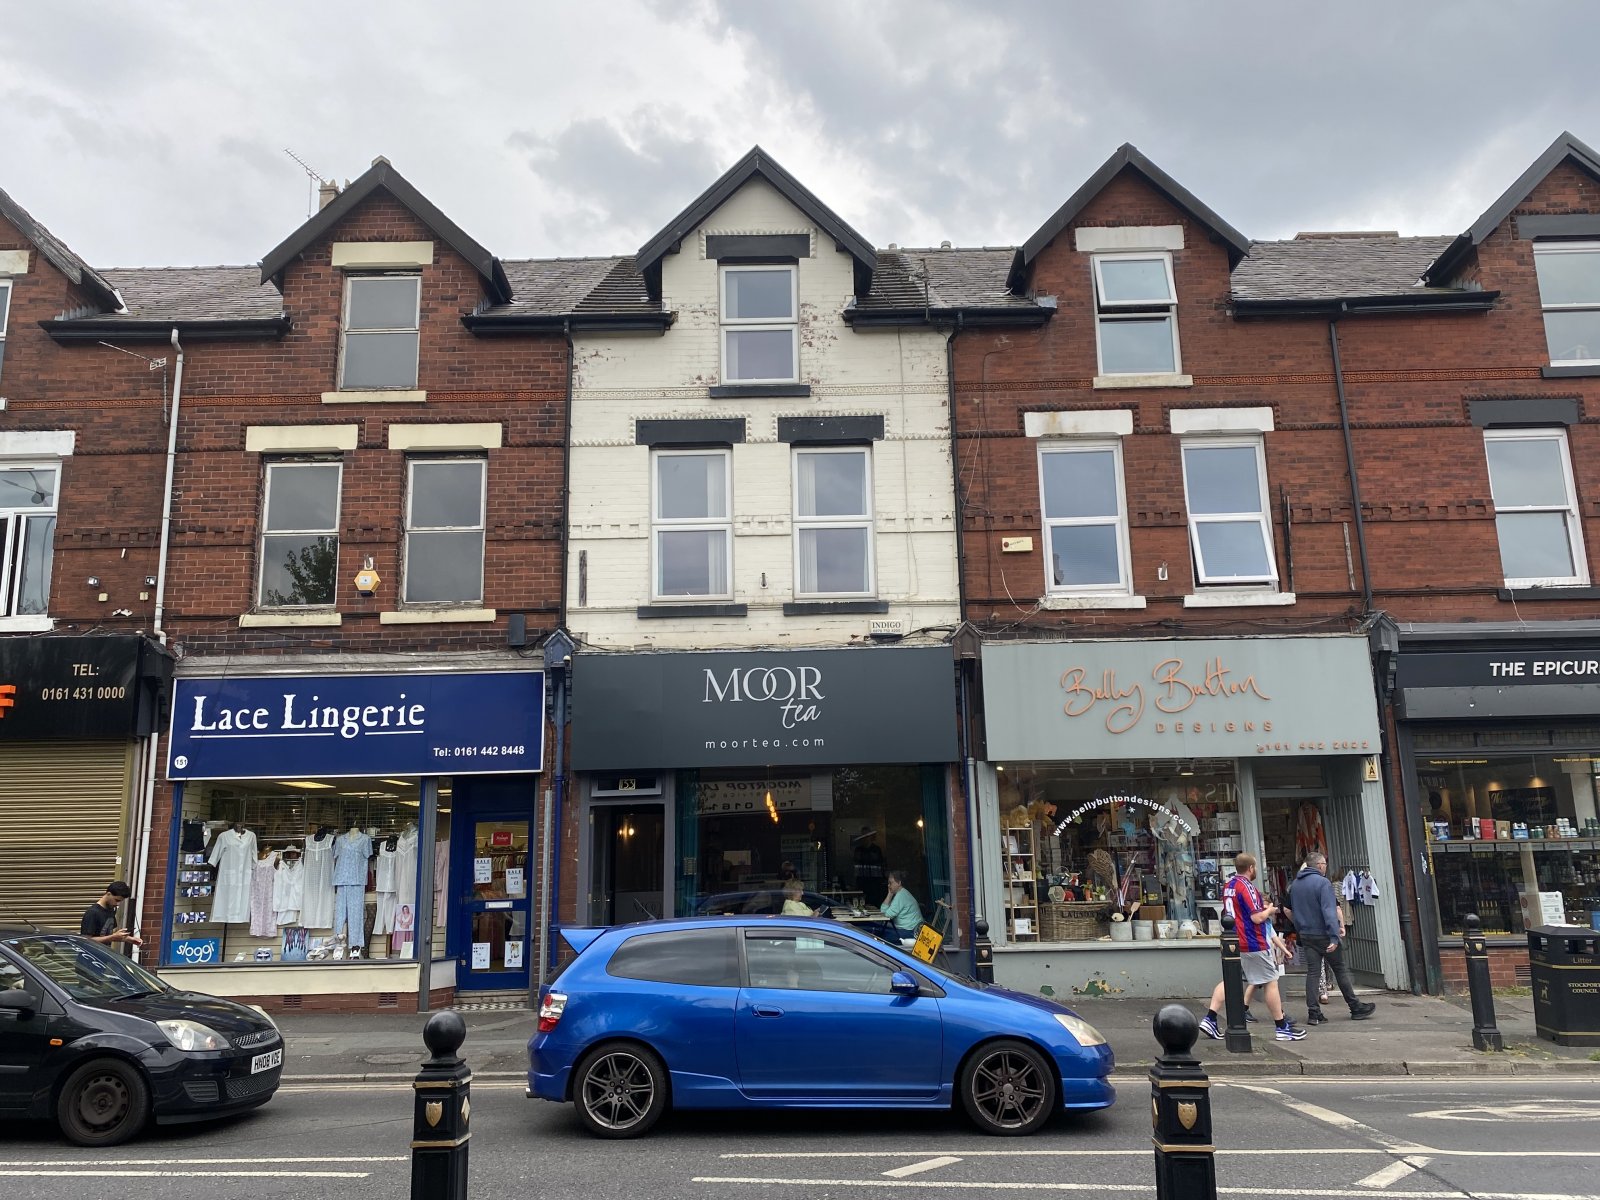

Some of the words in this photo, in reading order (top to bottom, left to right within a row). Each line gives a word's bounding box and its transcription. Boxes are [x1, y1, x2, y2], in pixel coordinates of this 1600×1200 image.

[872, 621, 901, 629] INDIGO
[72, 663, 100, 676] TEL:
[1489, 661, 1526, 677] THE
[1532, 660, 1600, 676] EPICUR
[702, 666, 826, 703] MOOR
[42, 687, 69, 700] 0161
[72, 687, 94, 699] 431
[97, 686, 125, 699] 0000
[1060, 667, 1145, 734] Belly
[1152, 656, 1272, 713] Button
[190, 695, 269, 731] Lace
[280, 693, 425, 739] Lingerie
[779, 697, 821, 729] tea
[1155, 720, 1274, 733] DESIGNS
[705, 738, 825, 749] moortea.com
[1256, 741, 1291, 754] 0161
[1299, 741, 1325, 751] 442
[433, 747, 452, 757] Tel:
[454, 746, 477, 757] 0161
[480, 746, 499, 756] 442
[501, 745, 525, 755] 8448
[175, 758, 188, 767] 151
[1053, 795, 1192, 837] www.bellybuttondesigns.com
[176, 940, 215, 964] sloggi
